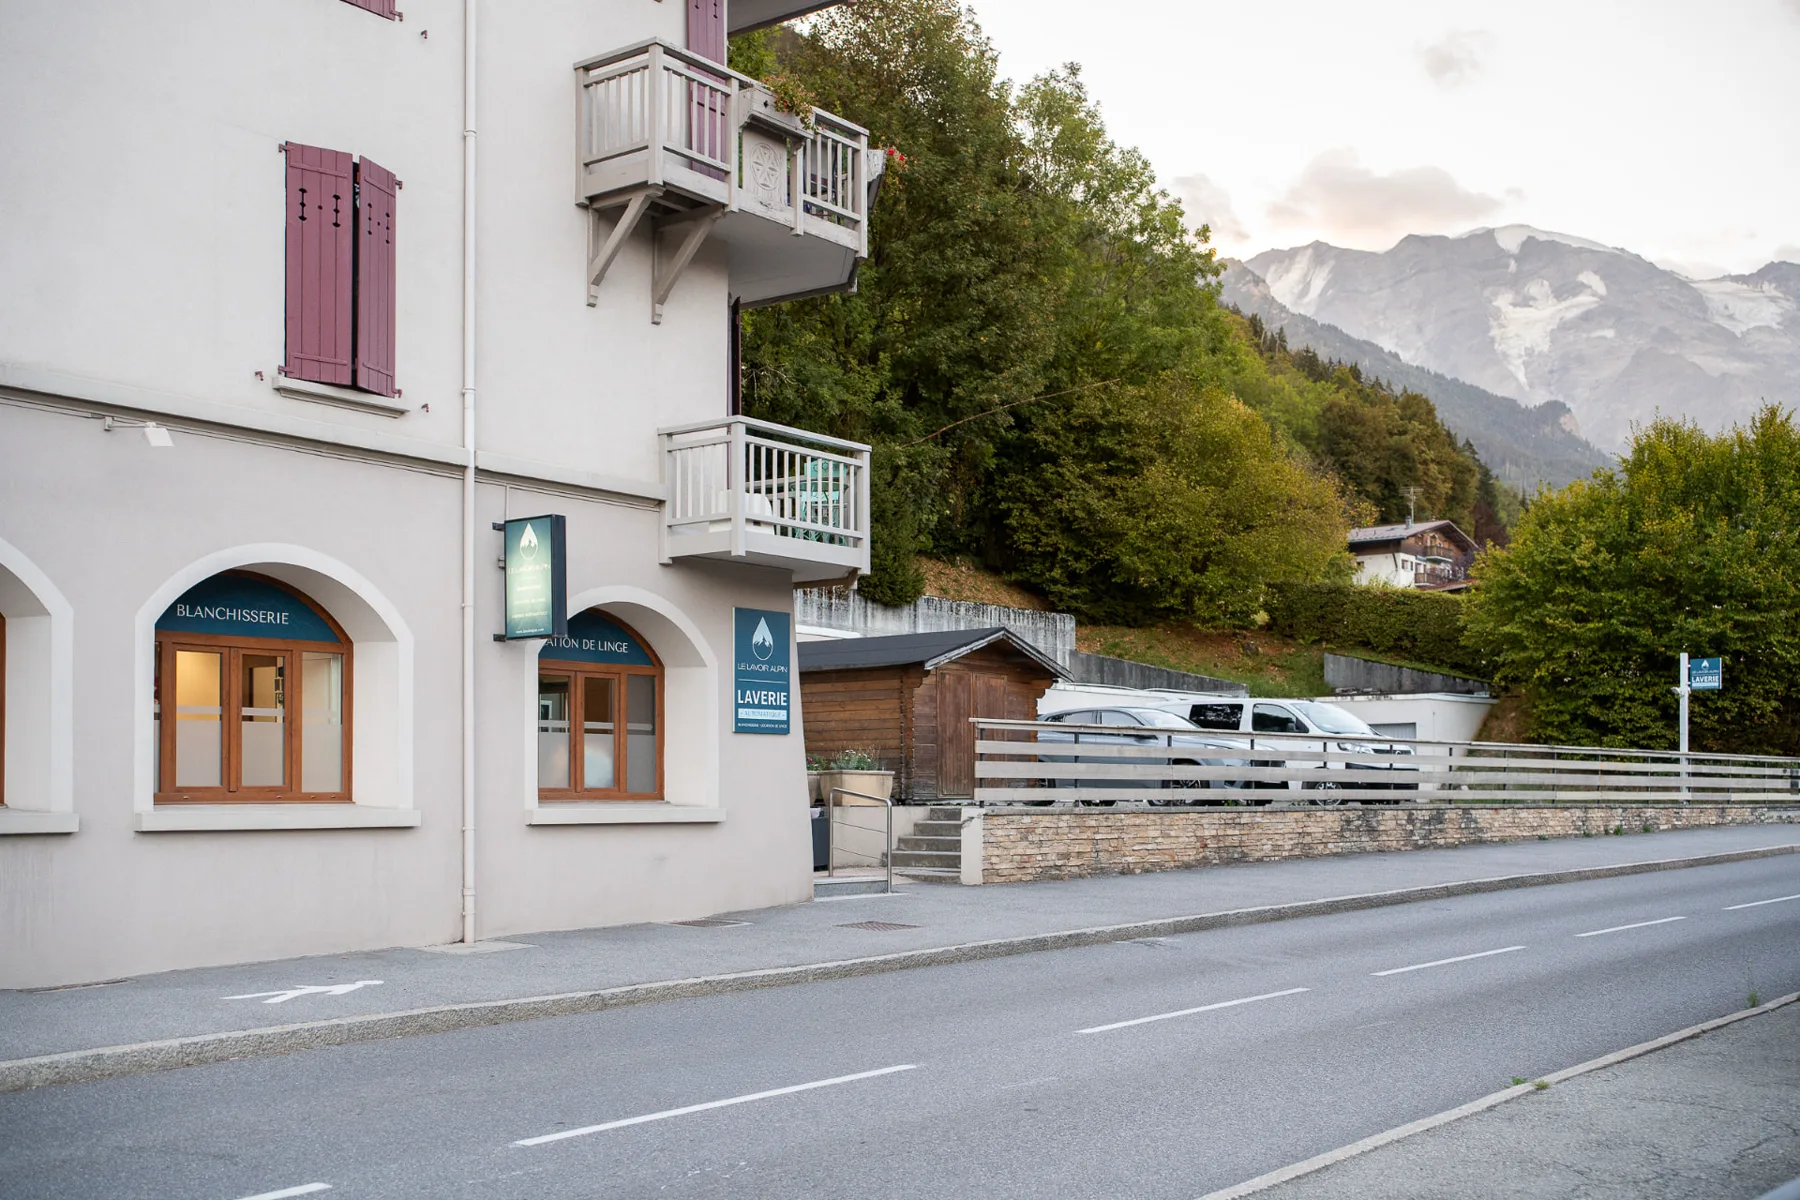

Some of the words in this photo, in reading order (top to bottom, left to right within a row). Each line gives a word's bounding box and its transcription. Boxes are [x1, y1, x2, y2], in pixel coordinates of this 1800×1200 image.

[177, 604, 289, 625] BLANCHISSERIE
[544, 637, 579, 648] ATION
[582, 639, 595, 650] DE
[598, 641, 628, 653] LINGE
[770, 665, 788, 673] ALPIN
[737, 689, 787, 706] LAVERIE
